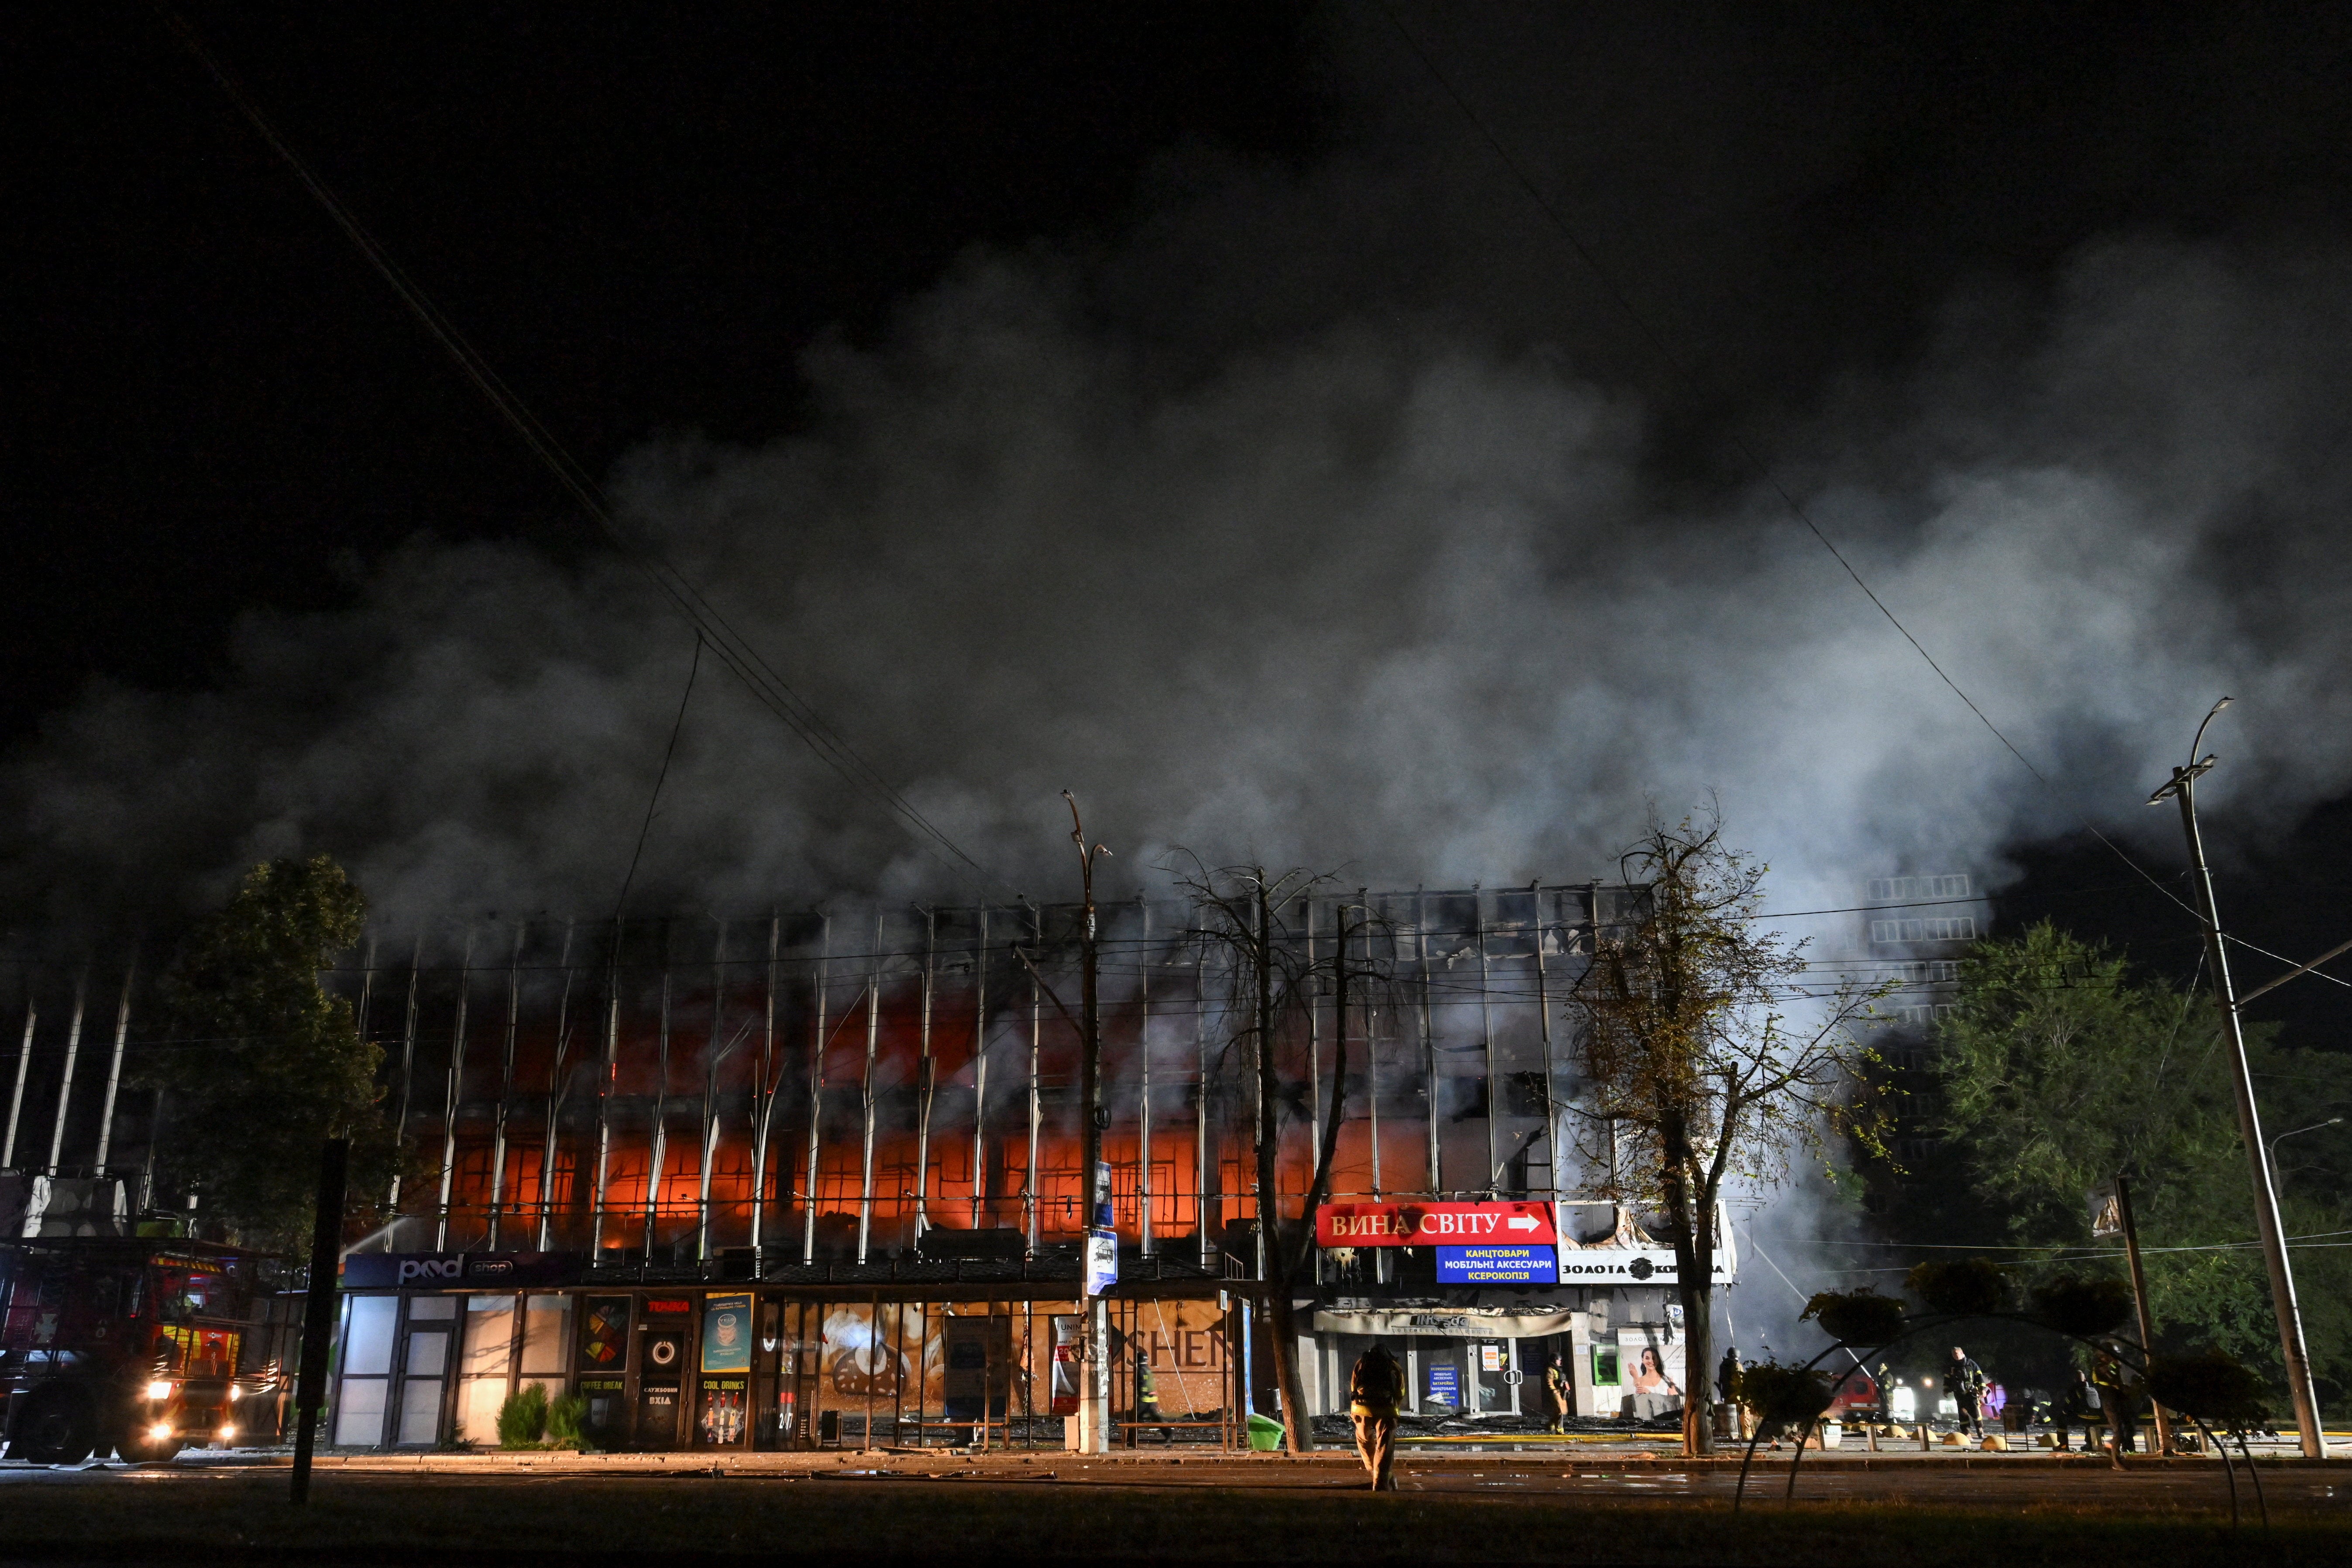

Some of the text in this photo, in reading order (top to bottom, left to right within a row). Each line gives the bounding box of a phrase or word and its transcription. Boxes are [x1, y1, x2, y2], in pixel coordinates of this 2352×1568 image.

[1331, 1213, 1501, 1236] ВИНА СВІТУ
[1466, 1249, 1529, 1258] КАНЦТОВАРИ
[398, 1253, 506, 1284] pod shop
[1562, 1265, 1626, 1274] ЗОЛОТА
[581, 1381, 623, 1389] COFFEE BREAK
[703, 1380, 744, 1390] COOL DRINKS
[649, 1396, 671, 1405] ВХІД
[779, 1412, 794, 1430] 24/7
